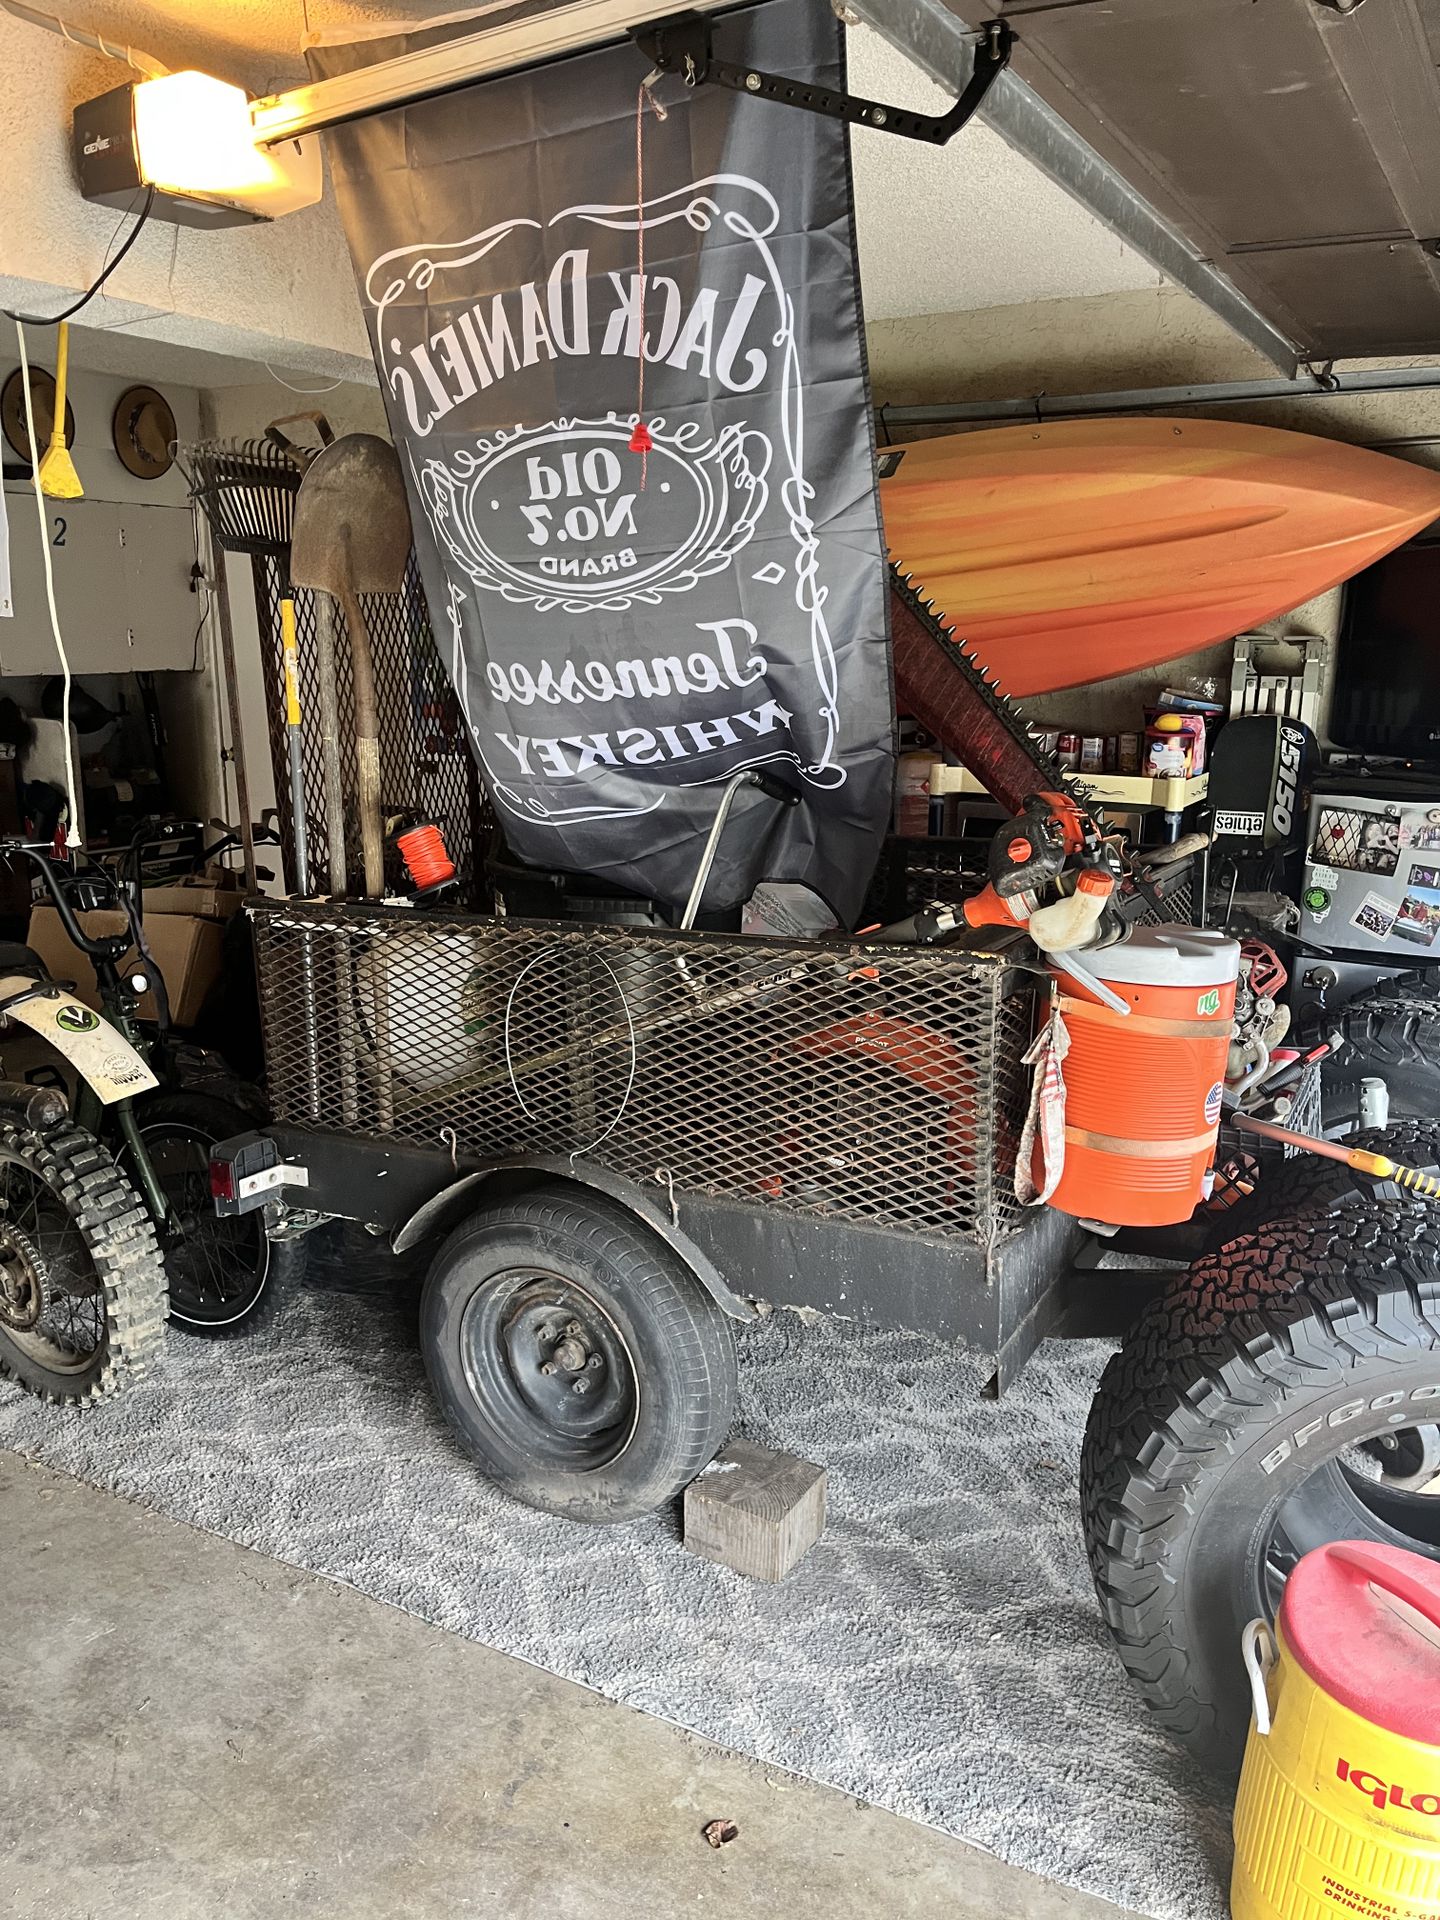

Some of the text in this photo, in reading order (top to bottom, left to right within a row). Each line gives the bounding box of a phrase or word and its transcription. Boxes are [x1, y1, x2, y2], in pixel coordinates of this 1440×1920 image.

[53, 517, 67, 546] 2
[1273, 740, 1300, 836] 5150
[1216, 816, 1263, 834] etnies
[1322, 1875, 1397, 1914] INDUSTRIAL
[1324, 1888, 1391, 1920] DRINKING
